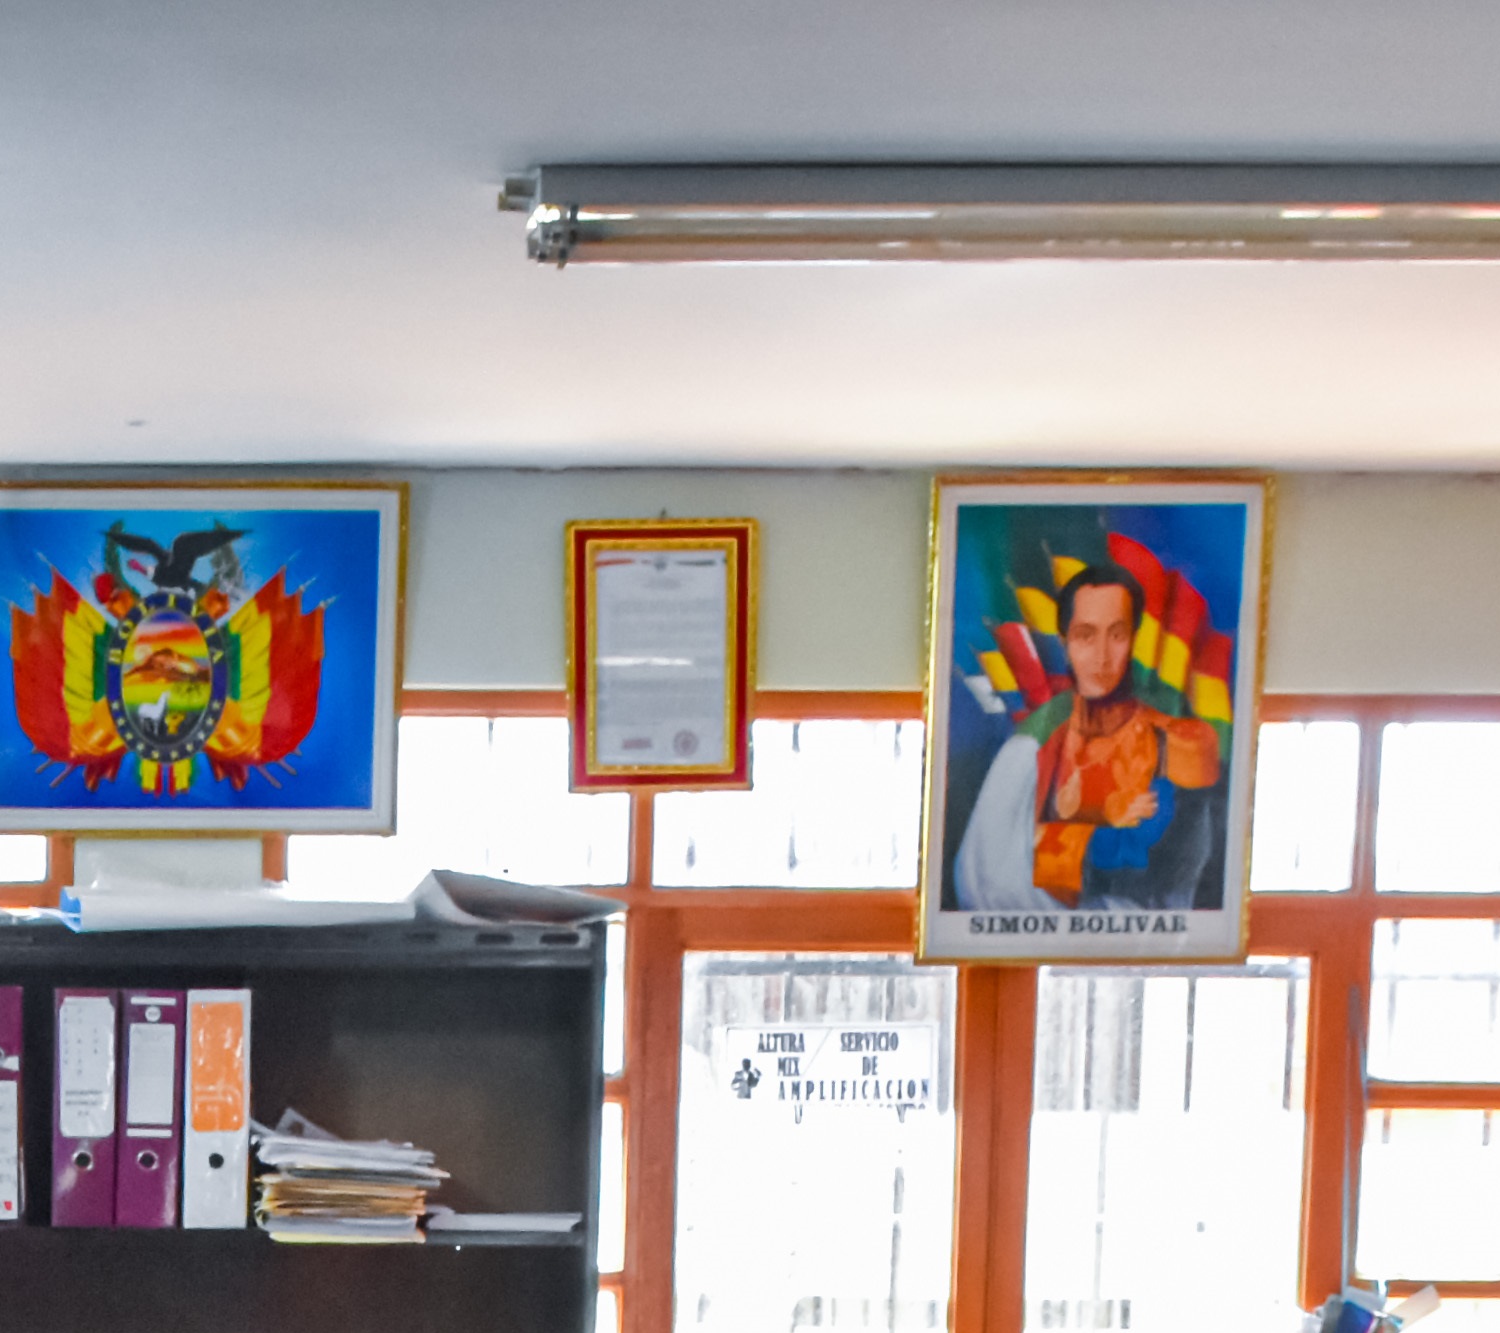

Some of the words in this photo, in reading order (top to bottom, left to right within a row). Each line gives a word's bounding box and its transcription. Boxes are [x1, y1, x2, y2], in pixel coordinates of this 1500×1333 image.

[970, 914, 1059, 935] SIMON
[1069, 914, 1188, 934] BOLIVAR
[757, 1032, 805, 1053] ALTURA
[840, 1031, 899, 1052] SERVICIO
[862, 1055, 878, 1076] DE
[778, 1078, 930, 1101] AMPLIFICACION
